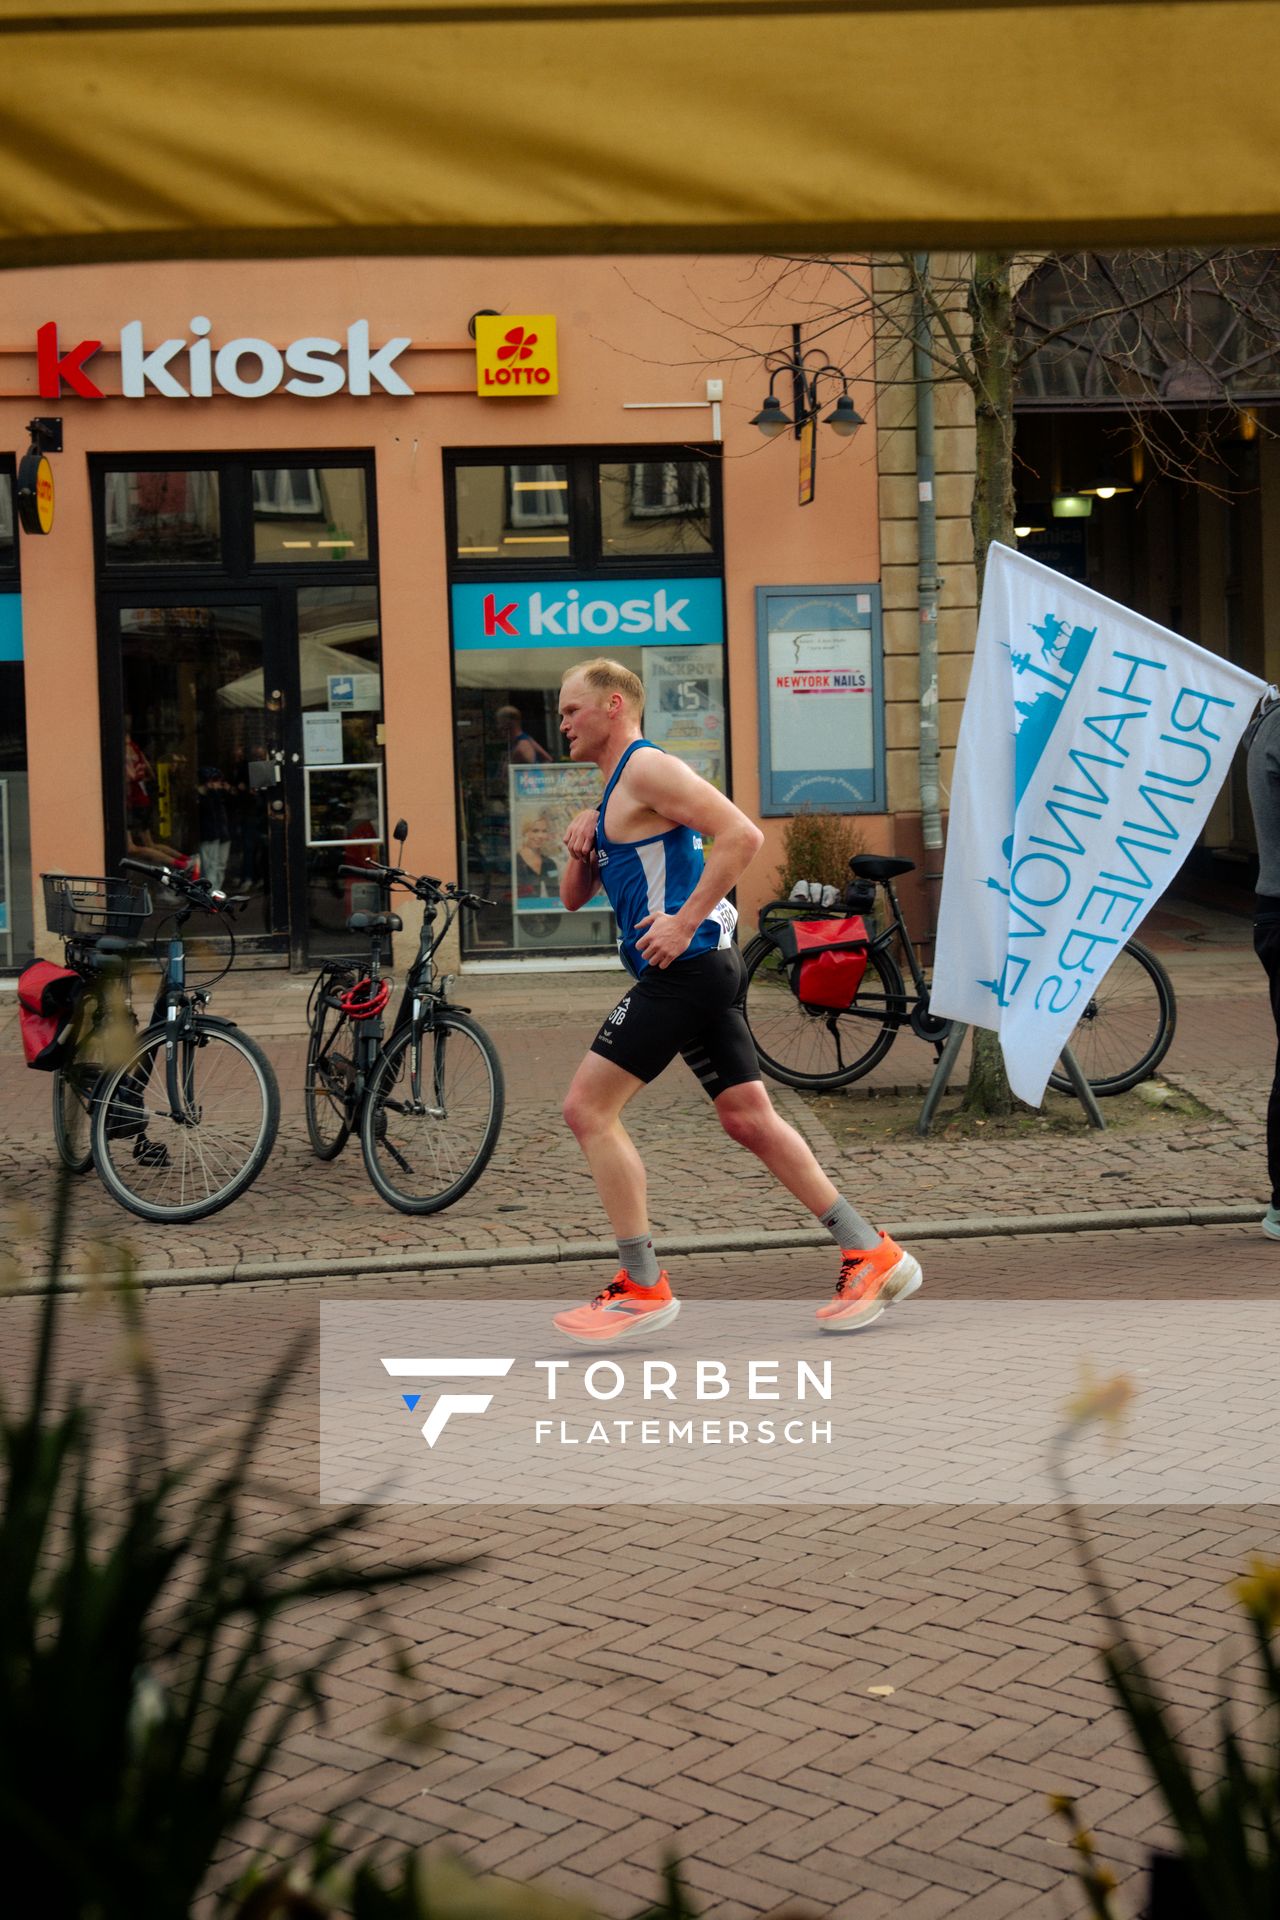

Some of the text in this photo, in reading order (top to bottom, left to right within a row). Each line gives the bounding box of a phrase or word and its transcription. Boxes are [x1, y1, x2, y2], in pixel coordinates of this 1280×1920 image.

[37, 316, 415, 398] k kiosk
[484, 367, 551, 386] LOTTO
[483, 589, 691, 637] k kiosk
[652, 663, 715, 676] JACKPOT
[776, 674, 866, 688] NEWYORK NAILS
[677, 681, 700, 710] 15
